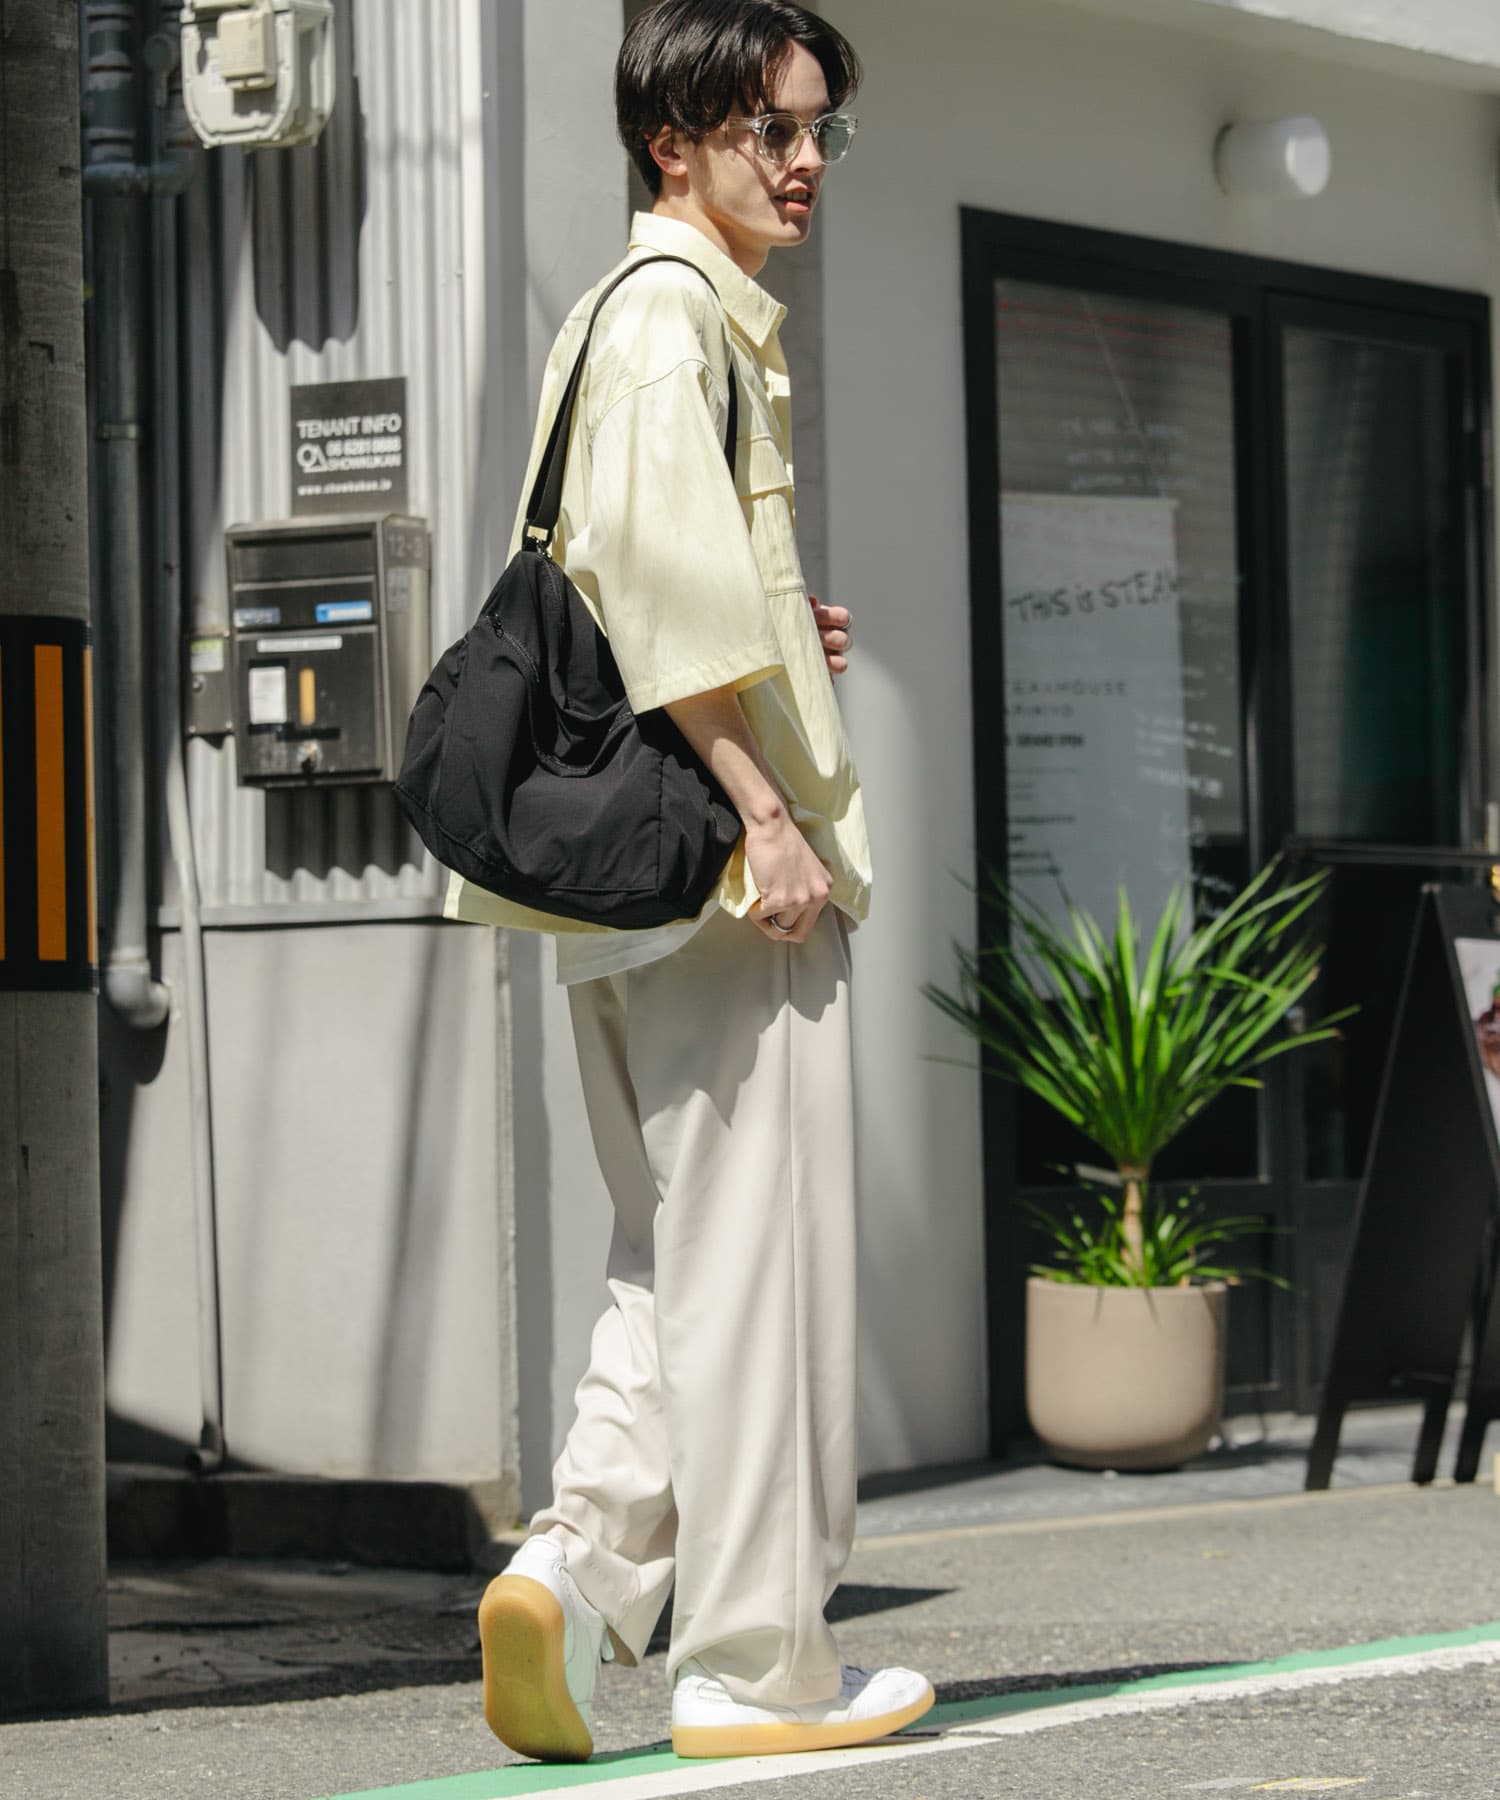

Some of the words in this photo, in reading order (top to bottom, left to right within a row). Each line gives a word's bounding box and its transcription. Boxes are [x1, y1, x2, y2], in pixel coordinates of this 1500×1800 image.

[296, 416, 360, 439] TENANT
[361, 413, 402, 434] INFO
[1007, 587, 1071, 622] THIS
